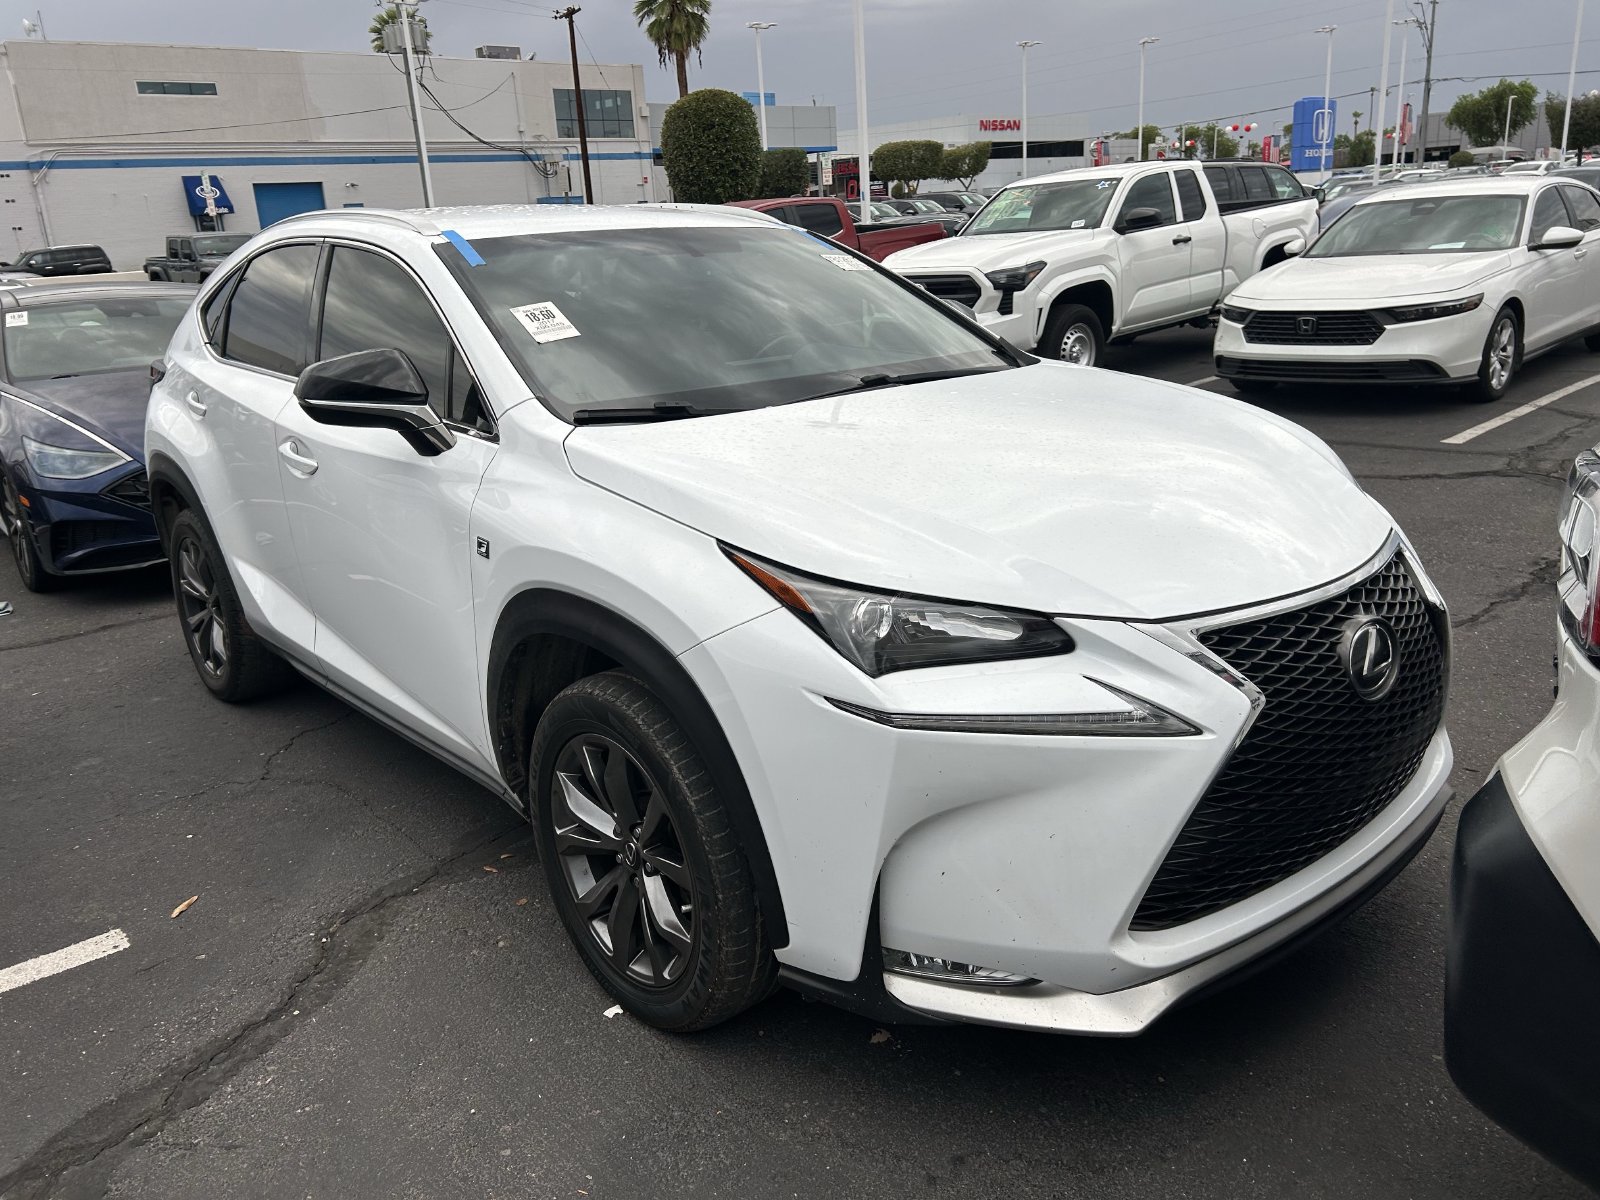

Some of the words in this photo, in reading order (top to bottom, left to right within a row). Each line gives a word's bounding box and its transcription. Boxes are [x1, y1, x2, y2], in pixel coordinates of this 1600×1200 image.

[979, 119, 1021, 131] NISSAN
[203, 206, 229, 214] Atate
[525, 310, 555, 323] 18:60
